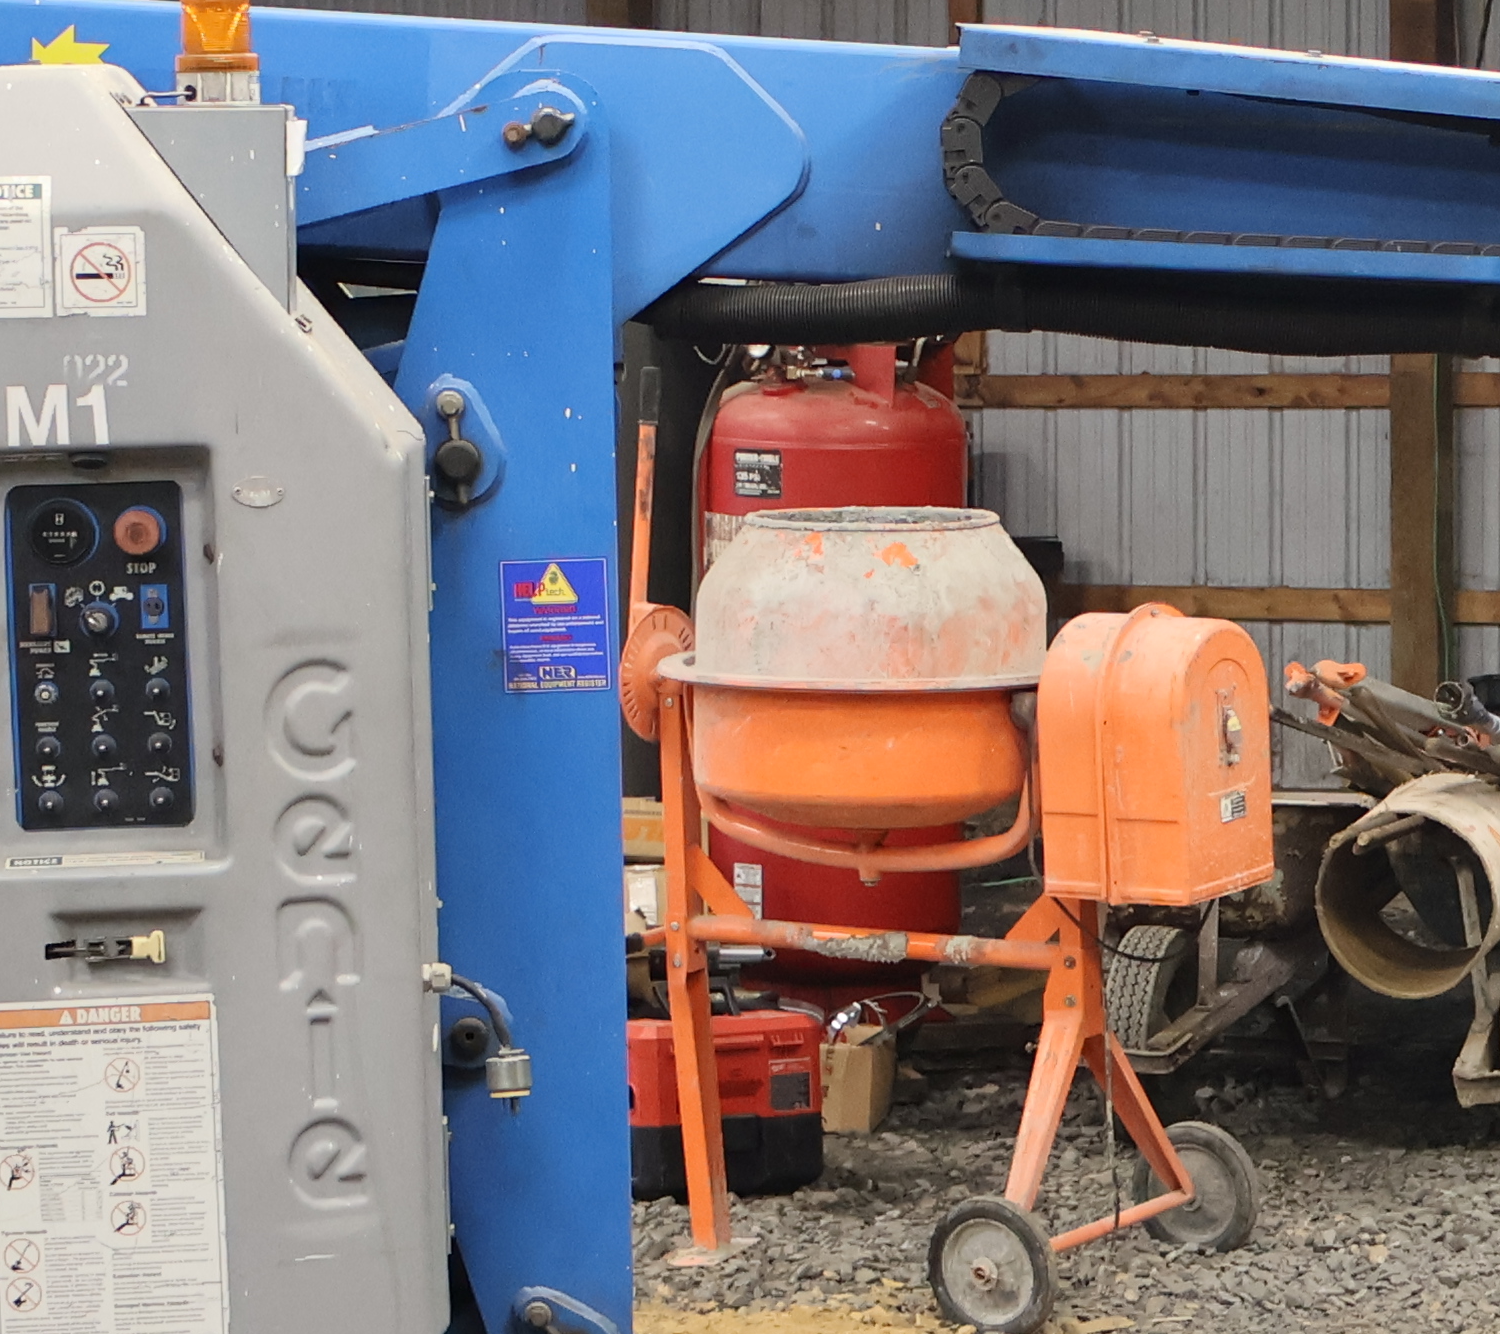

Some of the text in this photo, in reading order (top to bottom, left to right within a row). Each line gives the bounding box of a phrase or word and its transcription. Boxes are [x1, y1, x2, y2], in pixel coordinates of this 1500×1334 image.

[6, 384, 110, 447] M1
[126, 562, 157, 575] STOP
[540, 666, 574, 679] NER
[13, 858, 58, 867] NOTICE
[75, 1006, 142, 1025] DANGER
